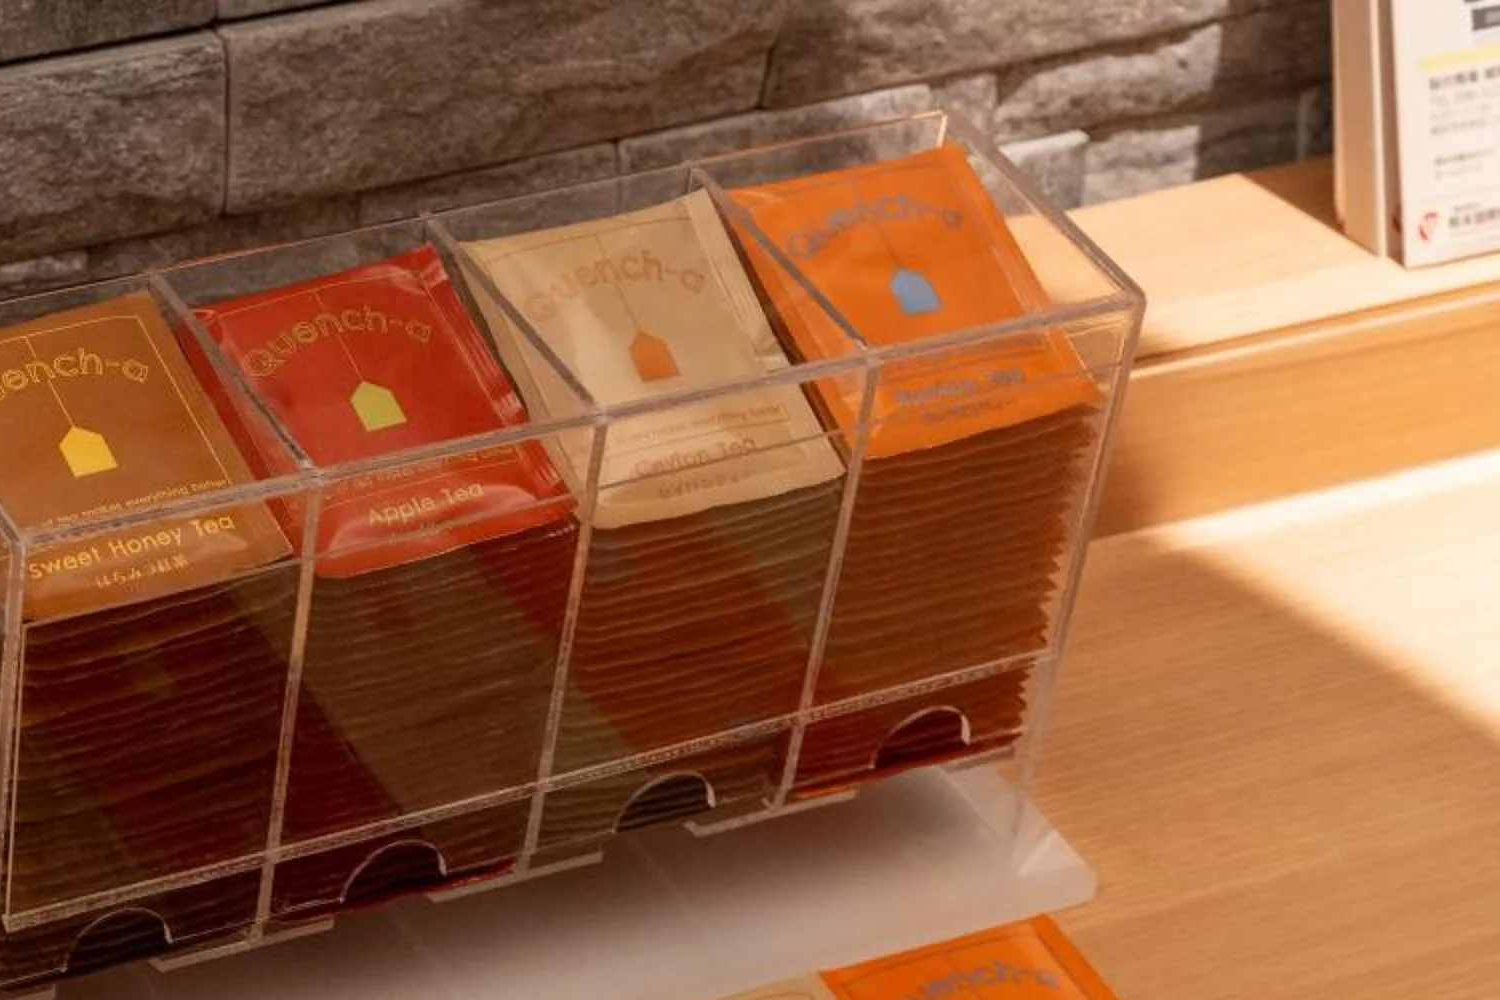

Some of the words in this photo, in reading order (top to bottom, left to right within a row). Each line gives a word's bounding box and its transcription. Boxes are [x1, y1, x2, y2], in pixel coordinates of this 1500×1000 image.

[522, 247, 706, 325] Quench-a
[242, 304, 431, 381] Quench-a
[368, 496, 436, 526] Apple
[439, 482, 485, 504] Tea
[28, 545, 100, 580] Sweet
[108, 526, 183, 559] Honey
[188, 515, 236, 538] Tea
